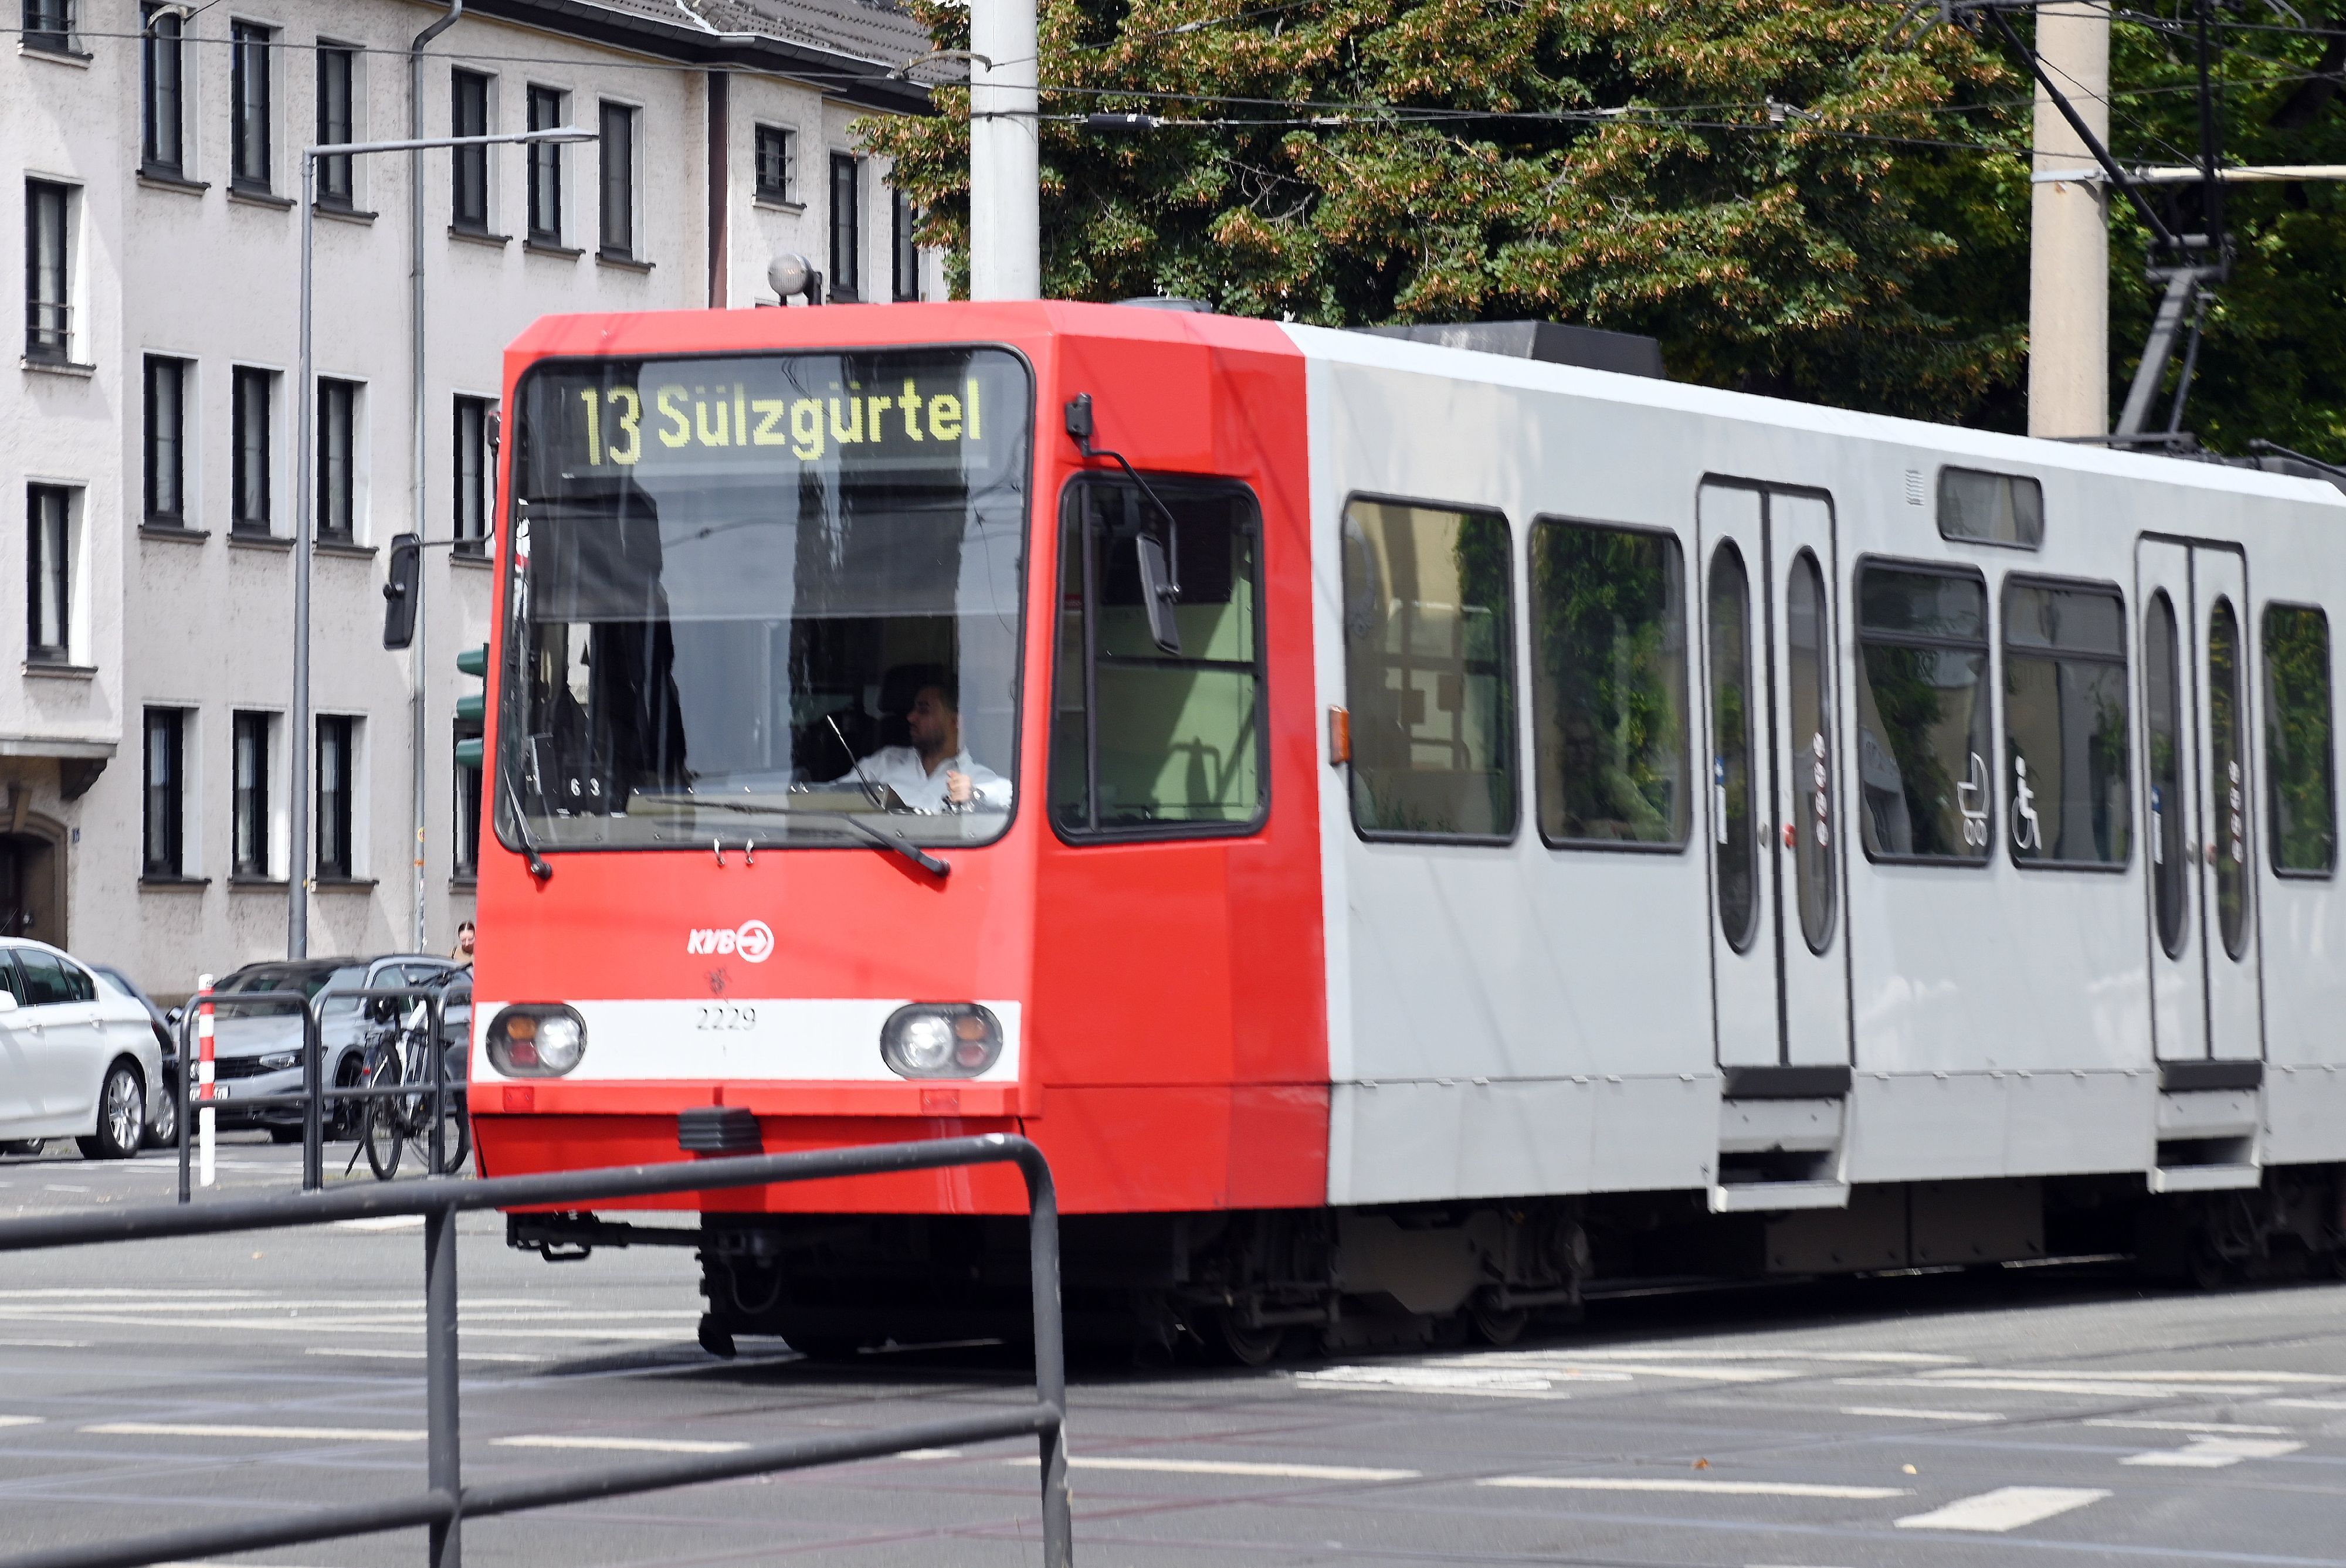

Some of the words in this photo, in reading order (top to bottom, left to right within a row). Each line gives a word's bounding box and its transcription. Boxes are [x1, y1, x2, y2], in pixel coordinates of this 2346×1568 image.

[581, 385, 641, 466] 13
[657, 376, 981, 461] Sülzgürtel
[687, 928, 737, 955] KVB
[696, 1006, 756, 1031] 2229
